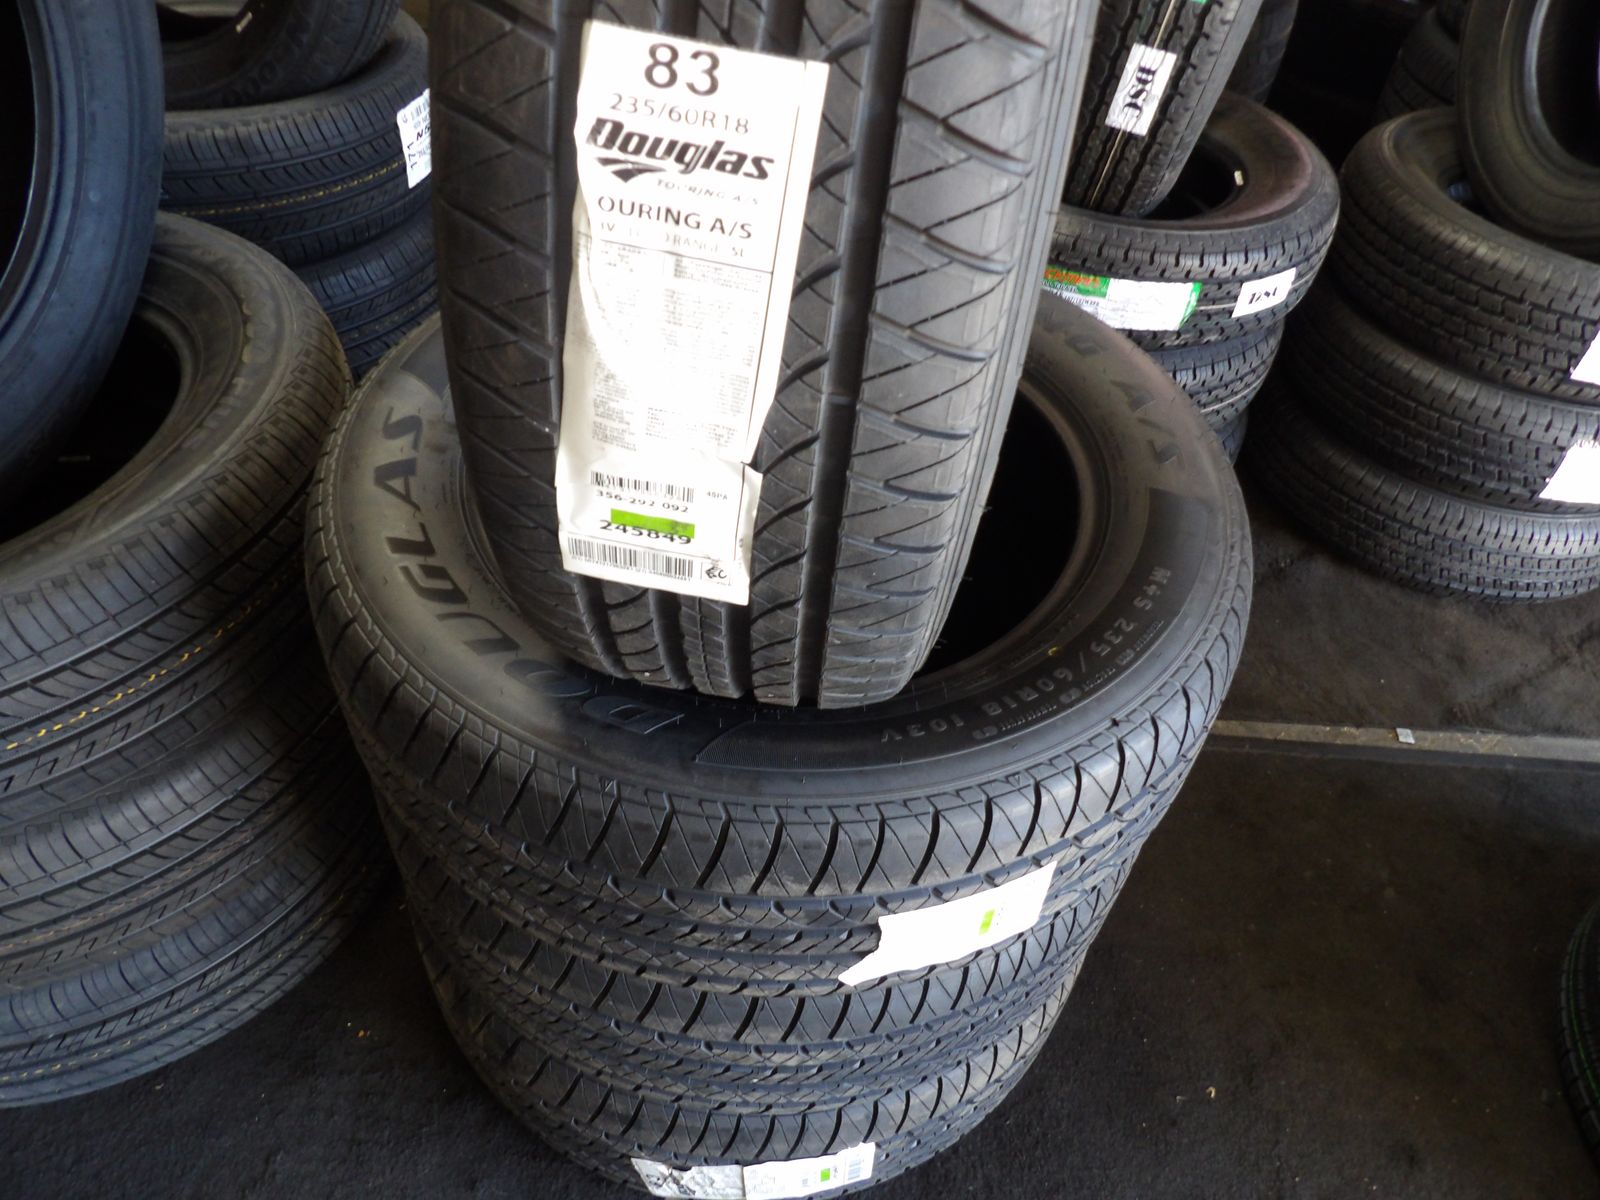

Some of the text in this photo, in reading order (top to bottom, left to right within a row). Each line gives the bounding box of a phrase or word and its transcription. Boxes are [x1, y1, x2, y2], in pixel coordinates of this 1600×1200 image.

[644, 42, 720, 97] 83
[609, 92, 750, 135] 235/60R18
[586, 117, 775, 181] Douglas
[709, 217, 753, 240] A/S
[599, 518, 692, 545] 245849
[373, 405, 685, 735] DOUGLAS
[981, 616, 1139, 717] 235/60R18
[880, 712, 967, 744] 103V
